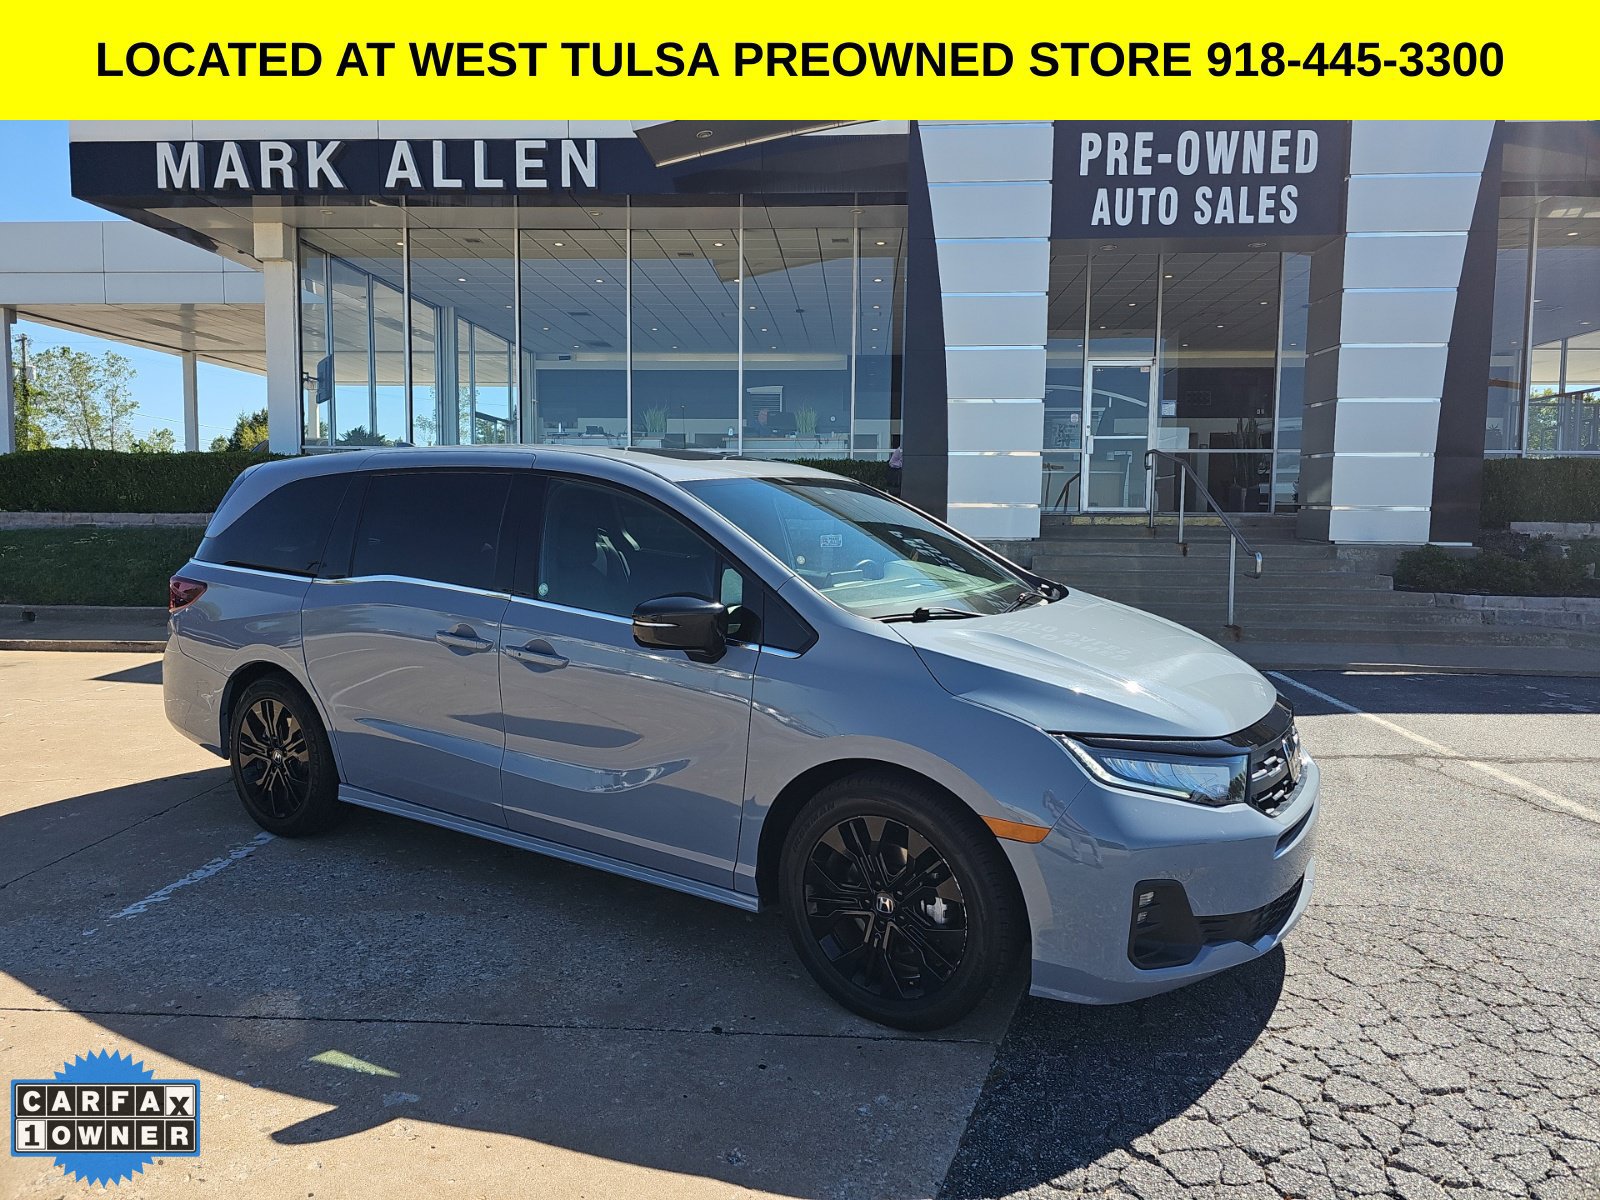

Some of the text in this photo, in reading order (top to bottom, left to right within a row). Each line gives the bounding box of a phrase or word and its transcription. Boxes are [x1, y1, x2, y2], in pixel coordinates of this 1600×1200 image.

[156, 139, 597, 189] MARK ALLEN
[1079, 129, 1319, 176] PRE-OWNED
[1090, 184, 1299, 226] AUTO SALES
